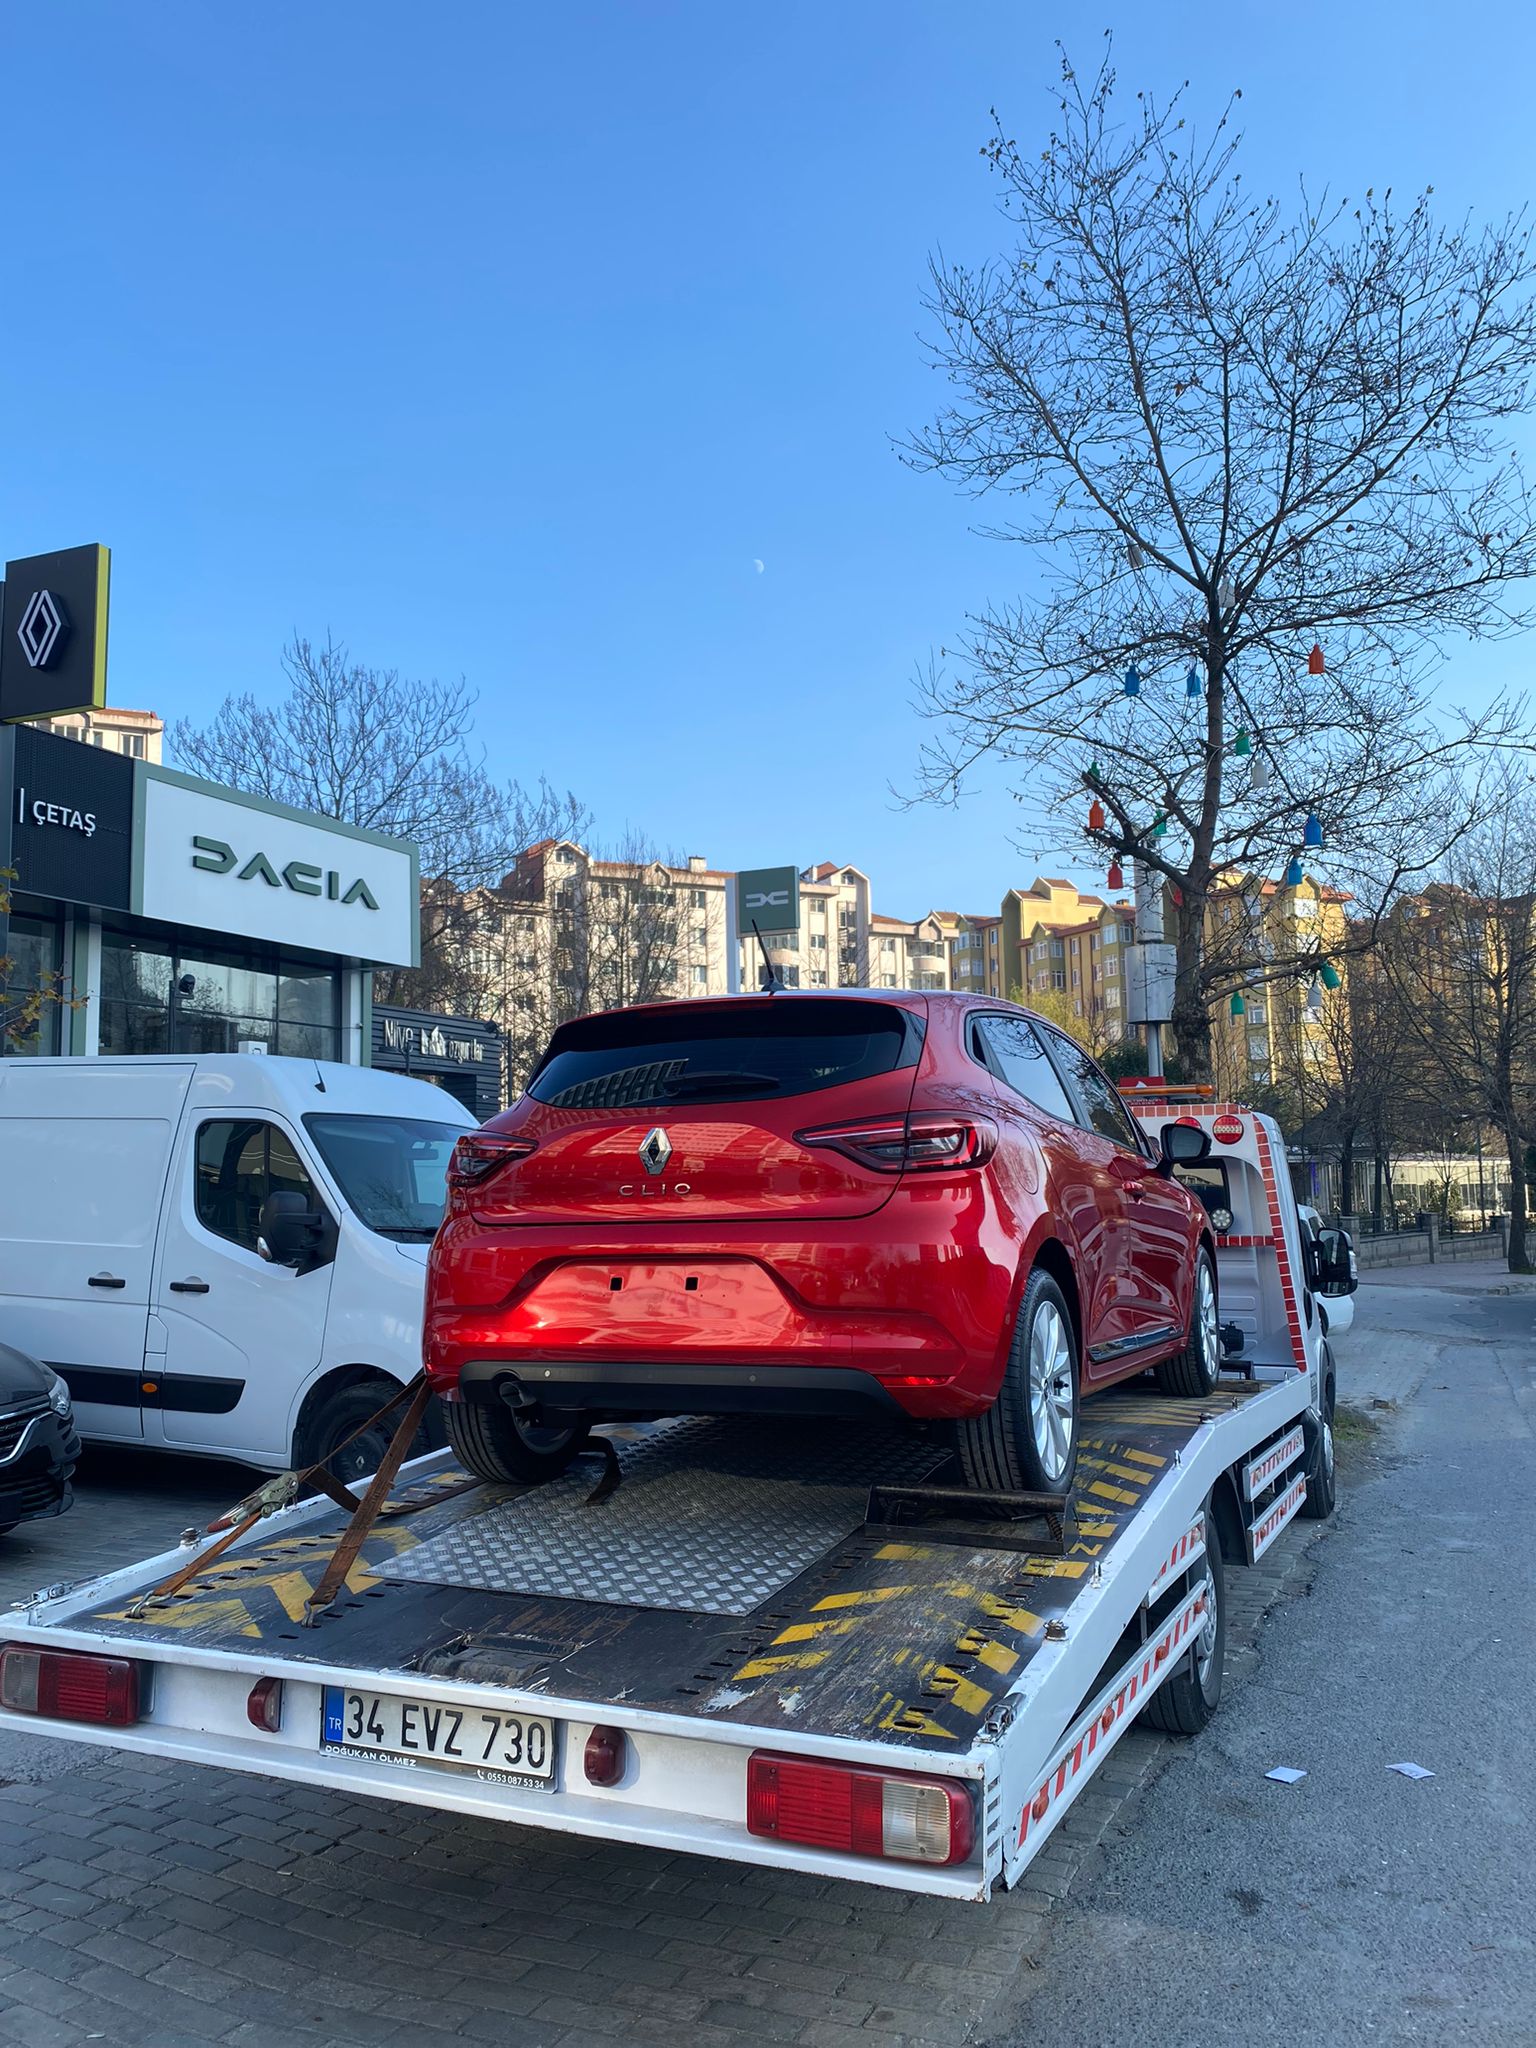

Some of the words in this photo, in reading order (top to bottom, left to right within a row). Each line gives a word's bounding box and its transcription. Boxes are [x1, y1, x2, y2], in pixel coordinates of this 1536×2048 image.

[33, 800, 96, 837] ÇETAŞ
[193, 835, 380, 911] DACIA
[619, 1183, 691, 1196] CLIO
[328, 1716, 342, 1731] TR
[347, 1695, 384, 1743] 34
[401, 1703, 463, 1756] EVZ
[480, 1714, 545, 1769] 730
[325, 1743, 377, 1761] DOĞUKAN
[379, 1750, 417, 1767] ÖLMEZ
[487, 1772, 506, 1783] 0553
[507, 1775, 522, 1786] 087
[523, 1778, 534, 1788] 53
[534, 1780, 545, 1790] 34
